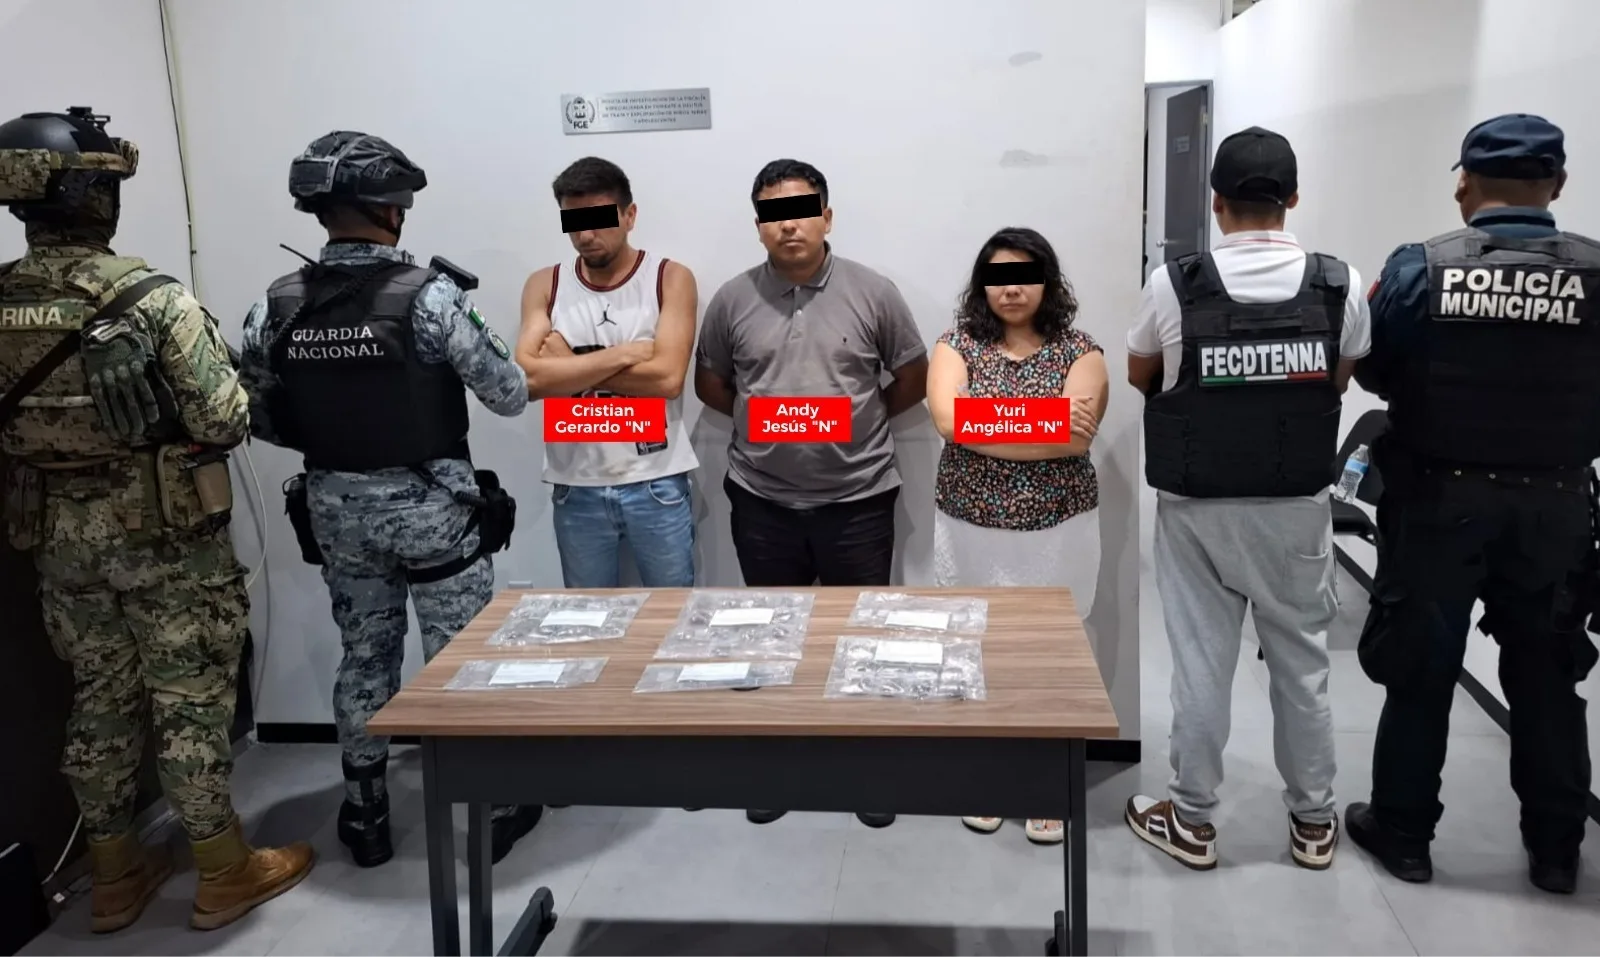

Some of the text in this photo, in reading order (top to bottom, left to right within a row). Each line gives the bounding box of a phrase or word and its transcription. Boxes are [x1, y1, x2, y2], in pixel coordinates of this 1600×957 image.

[573, 120, 589, 130] FGE
[1443, 268, 1585, 299] POLICÍA
[0, 306, 63, 326] RINA
[1440, 291, 1581, 325] MUNICIPAL
[292, 325, 374, 341] GUARDIA
[288, 343, 384, 360] NACIONAL
[1201, 341, 1327, 377] FECDTENNA
